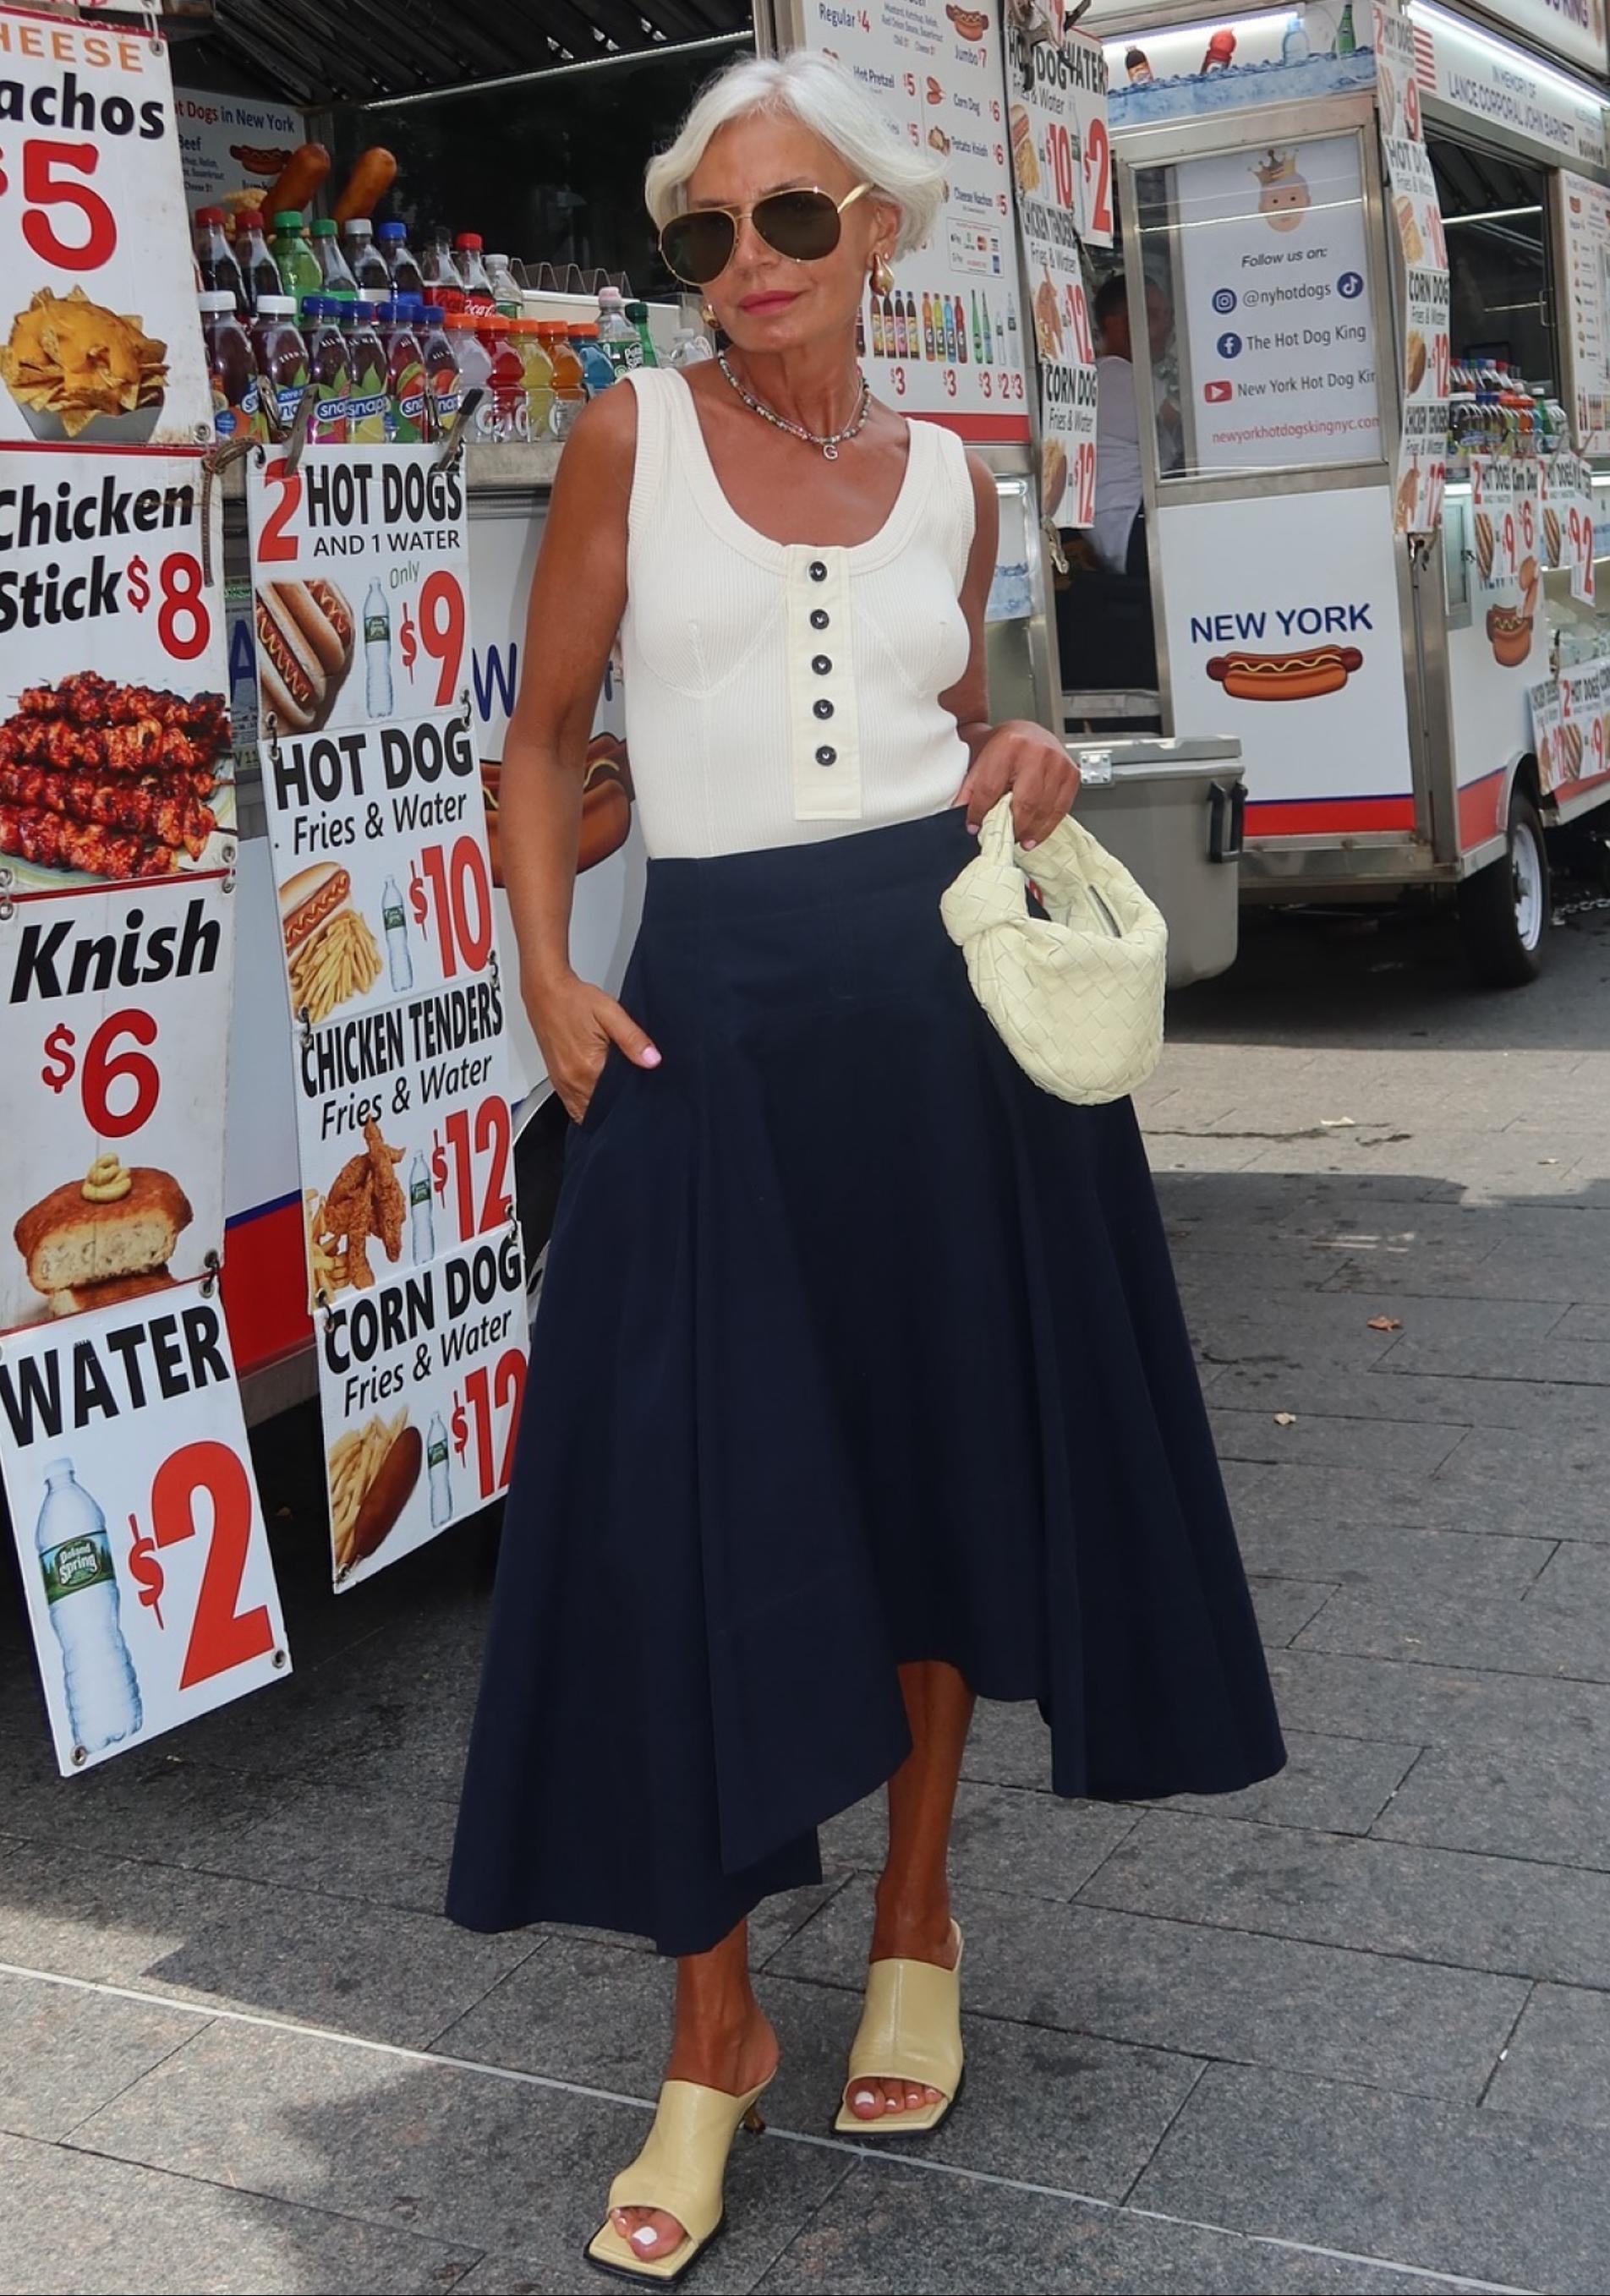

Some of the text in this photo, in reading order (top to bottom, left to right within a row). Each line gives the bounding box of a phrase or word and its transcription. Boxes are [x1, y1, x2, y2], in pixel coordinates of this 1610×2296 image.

[819, 3, 856, 28] Regular
[187, 101, 218, 125] Dogs
[221, 106, 233, 123] in
[237, 109, 264, 128] New
[266, 114, 295, 133] York
[868, 69, 895, 89] Pretzel
[953, 93, 968, 109] Corn
[968, 97, 980, 117] Dog
[1240, 247, 1328, 269] Follow us on:
[1242, 282, 1332, 308] @nyhotdogs
[1246, 325, 1366, 351] The Hot Dog King
[1046, 364, 1076, 405] CORN
[1238, 382, 1267, 397] New
[1269, 377, 1297, 393] York
[1302, 374, 1325, 390] Hot
[1328, 371, 1354, 389] Dog
[0, 475, 194, 551] Chicken
[257, 457, 463, 562] 2 HOT DOGS
[313, 530, 461, 558] AND 1 WATER
[0, 551, 211, 661] Stick $8
[390, 560, 420, 590] Only
[400, 570, 466, 707] $9
[1191, 603, 1373, 644] NEW YORK
[273, 718, 474, 811] HOT DOG
[294, 792, 467, 855] Fries & Water
[409, 835, 492, 979] $10
[9, 899, 222, 1003] Knish
[42, 1008, 161, 1139] $6
[302, 982, 503, 1098] CHICKEN TENDERS
[321, 1054, 492, 1141] Fries & Water
[432, 1095, 512, 1242] $12
[325, 1237, 523, 1375] CORN DOG
[0, 1304, 231, 1449] WATER
[344, 1308, 512, 1418] Fries & Water
[452, 1348, 529, 1501] $12
[59, 1554, 98, 1585] Spring
[128, 1440, 275, 1691] $2
